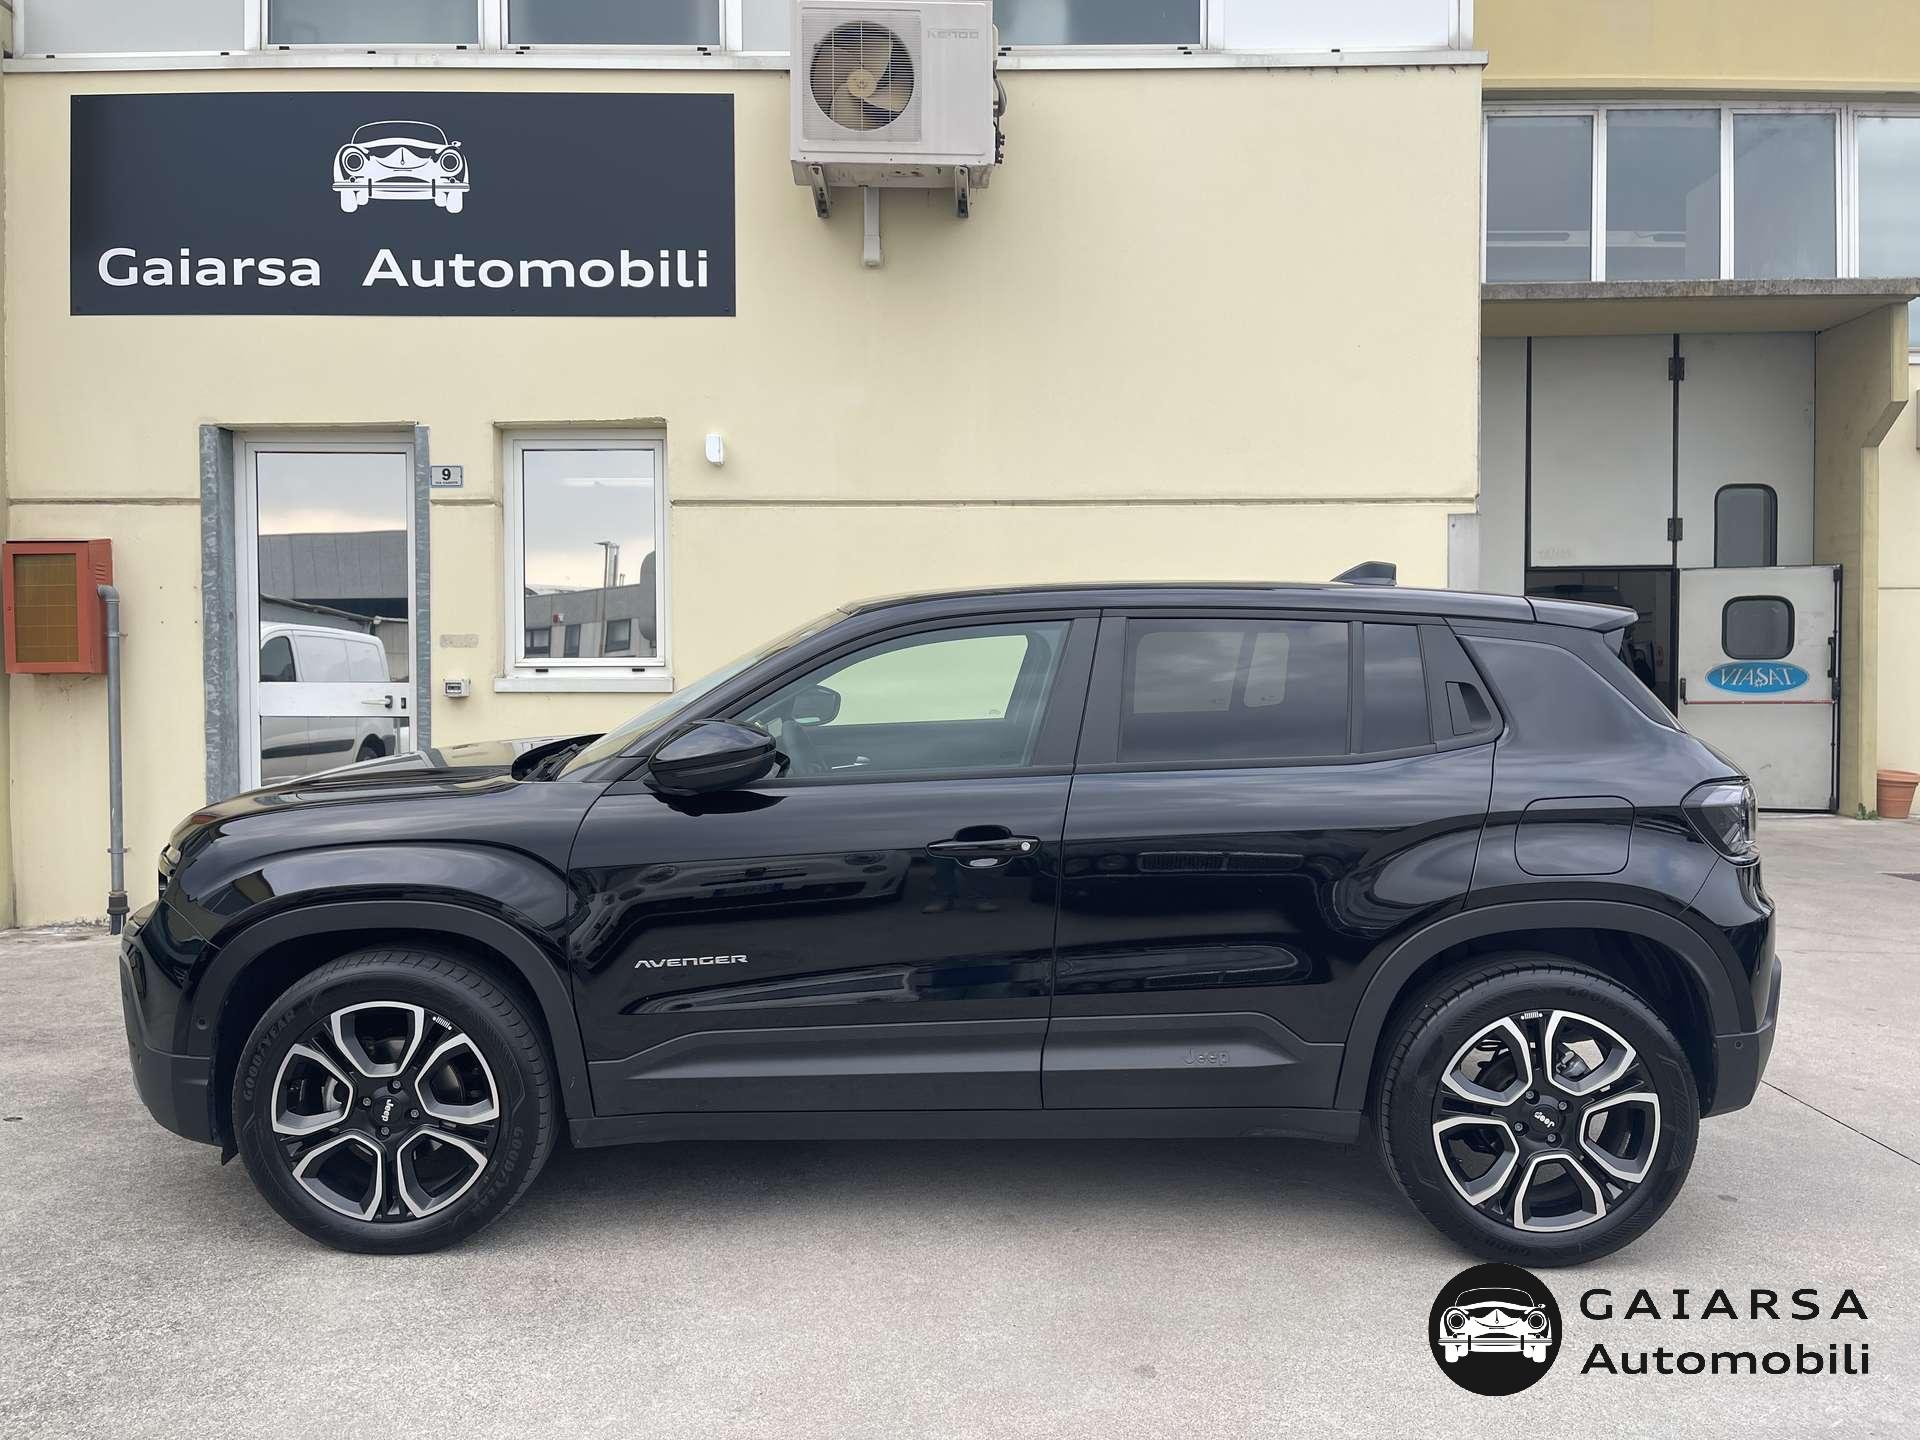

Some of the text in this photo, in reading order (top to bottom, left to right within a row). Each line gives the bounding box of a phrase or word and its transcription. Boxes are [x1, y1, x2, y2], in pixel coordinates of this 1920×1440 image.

[98, 247, 708, 288] Gaiarsa Automobili
[442, 468, 451, 480] 9
[1720, 668, 1793, 687] VIASAT
[634, 954, 749, 969] AVENGER
[1183, 1047, 1231, 1066] Jeep
[381, 1099, 394, 1122] Jeep
[1534, 1111, 1555, 1128] Jeep
